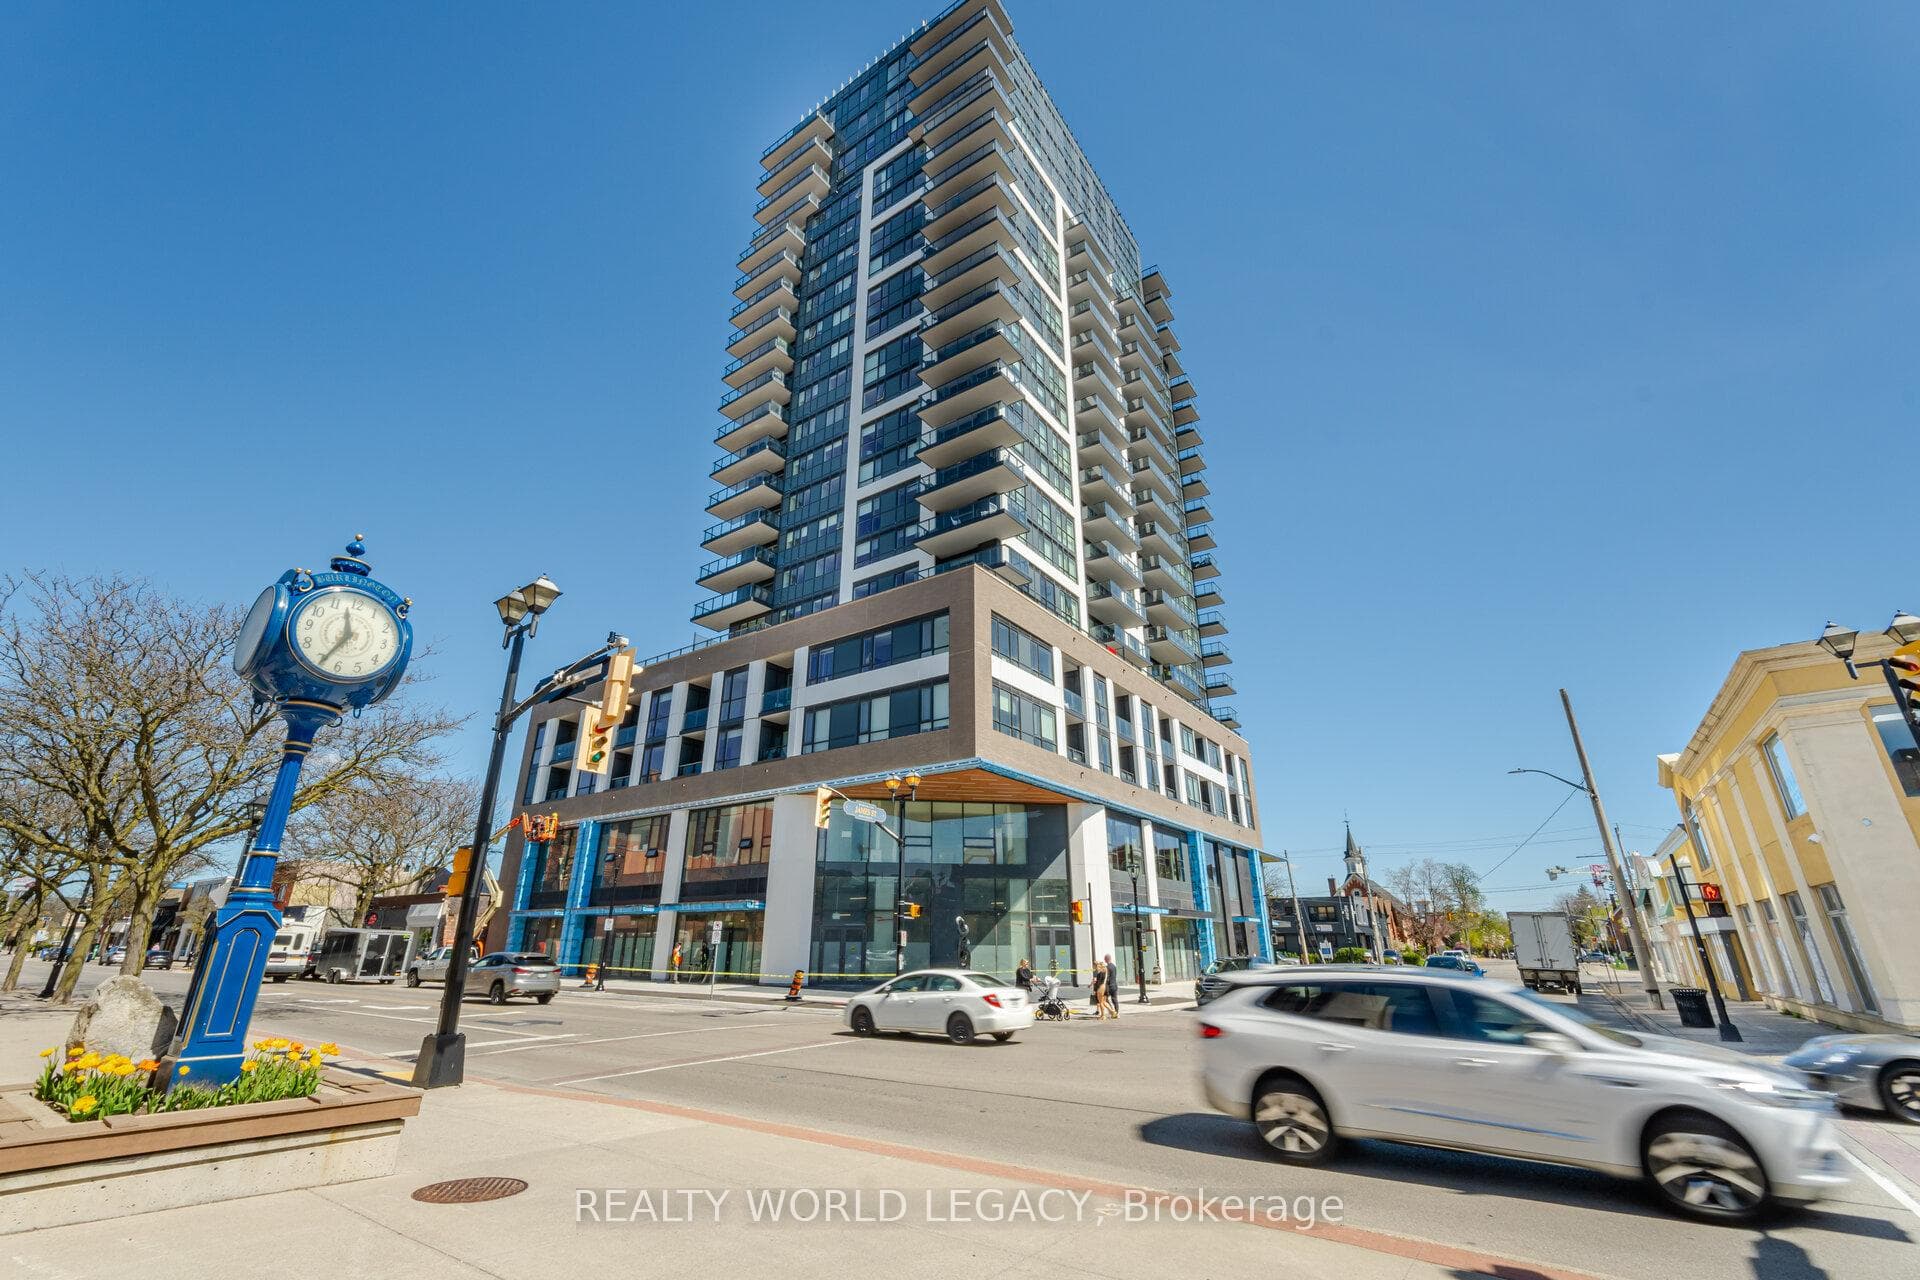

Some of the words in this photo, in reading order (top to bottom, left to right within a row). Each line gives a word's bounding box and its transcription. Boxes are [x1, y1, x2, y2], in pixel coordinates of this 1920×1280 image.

[330, 598, 341, 610] 11
[351, 598, 364, 611] 12
[311, 605, 325, 618] 10
[304, 619, 314, 631] 9
[382, 623, 390, 633] 2
[302, 636, 312, 649] 8
[380, 640, 387, 649] 3
[370, 653, 379, 665] 4
[333, 660, 343, 673] 6
[352, 661, 362, 673] 5
